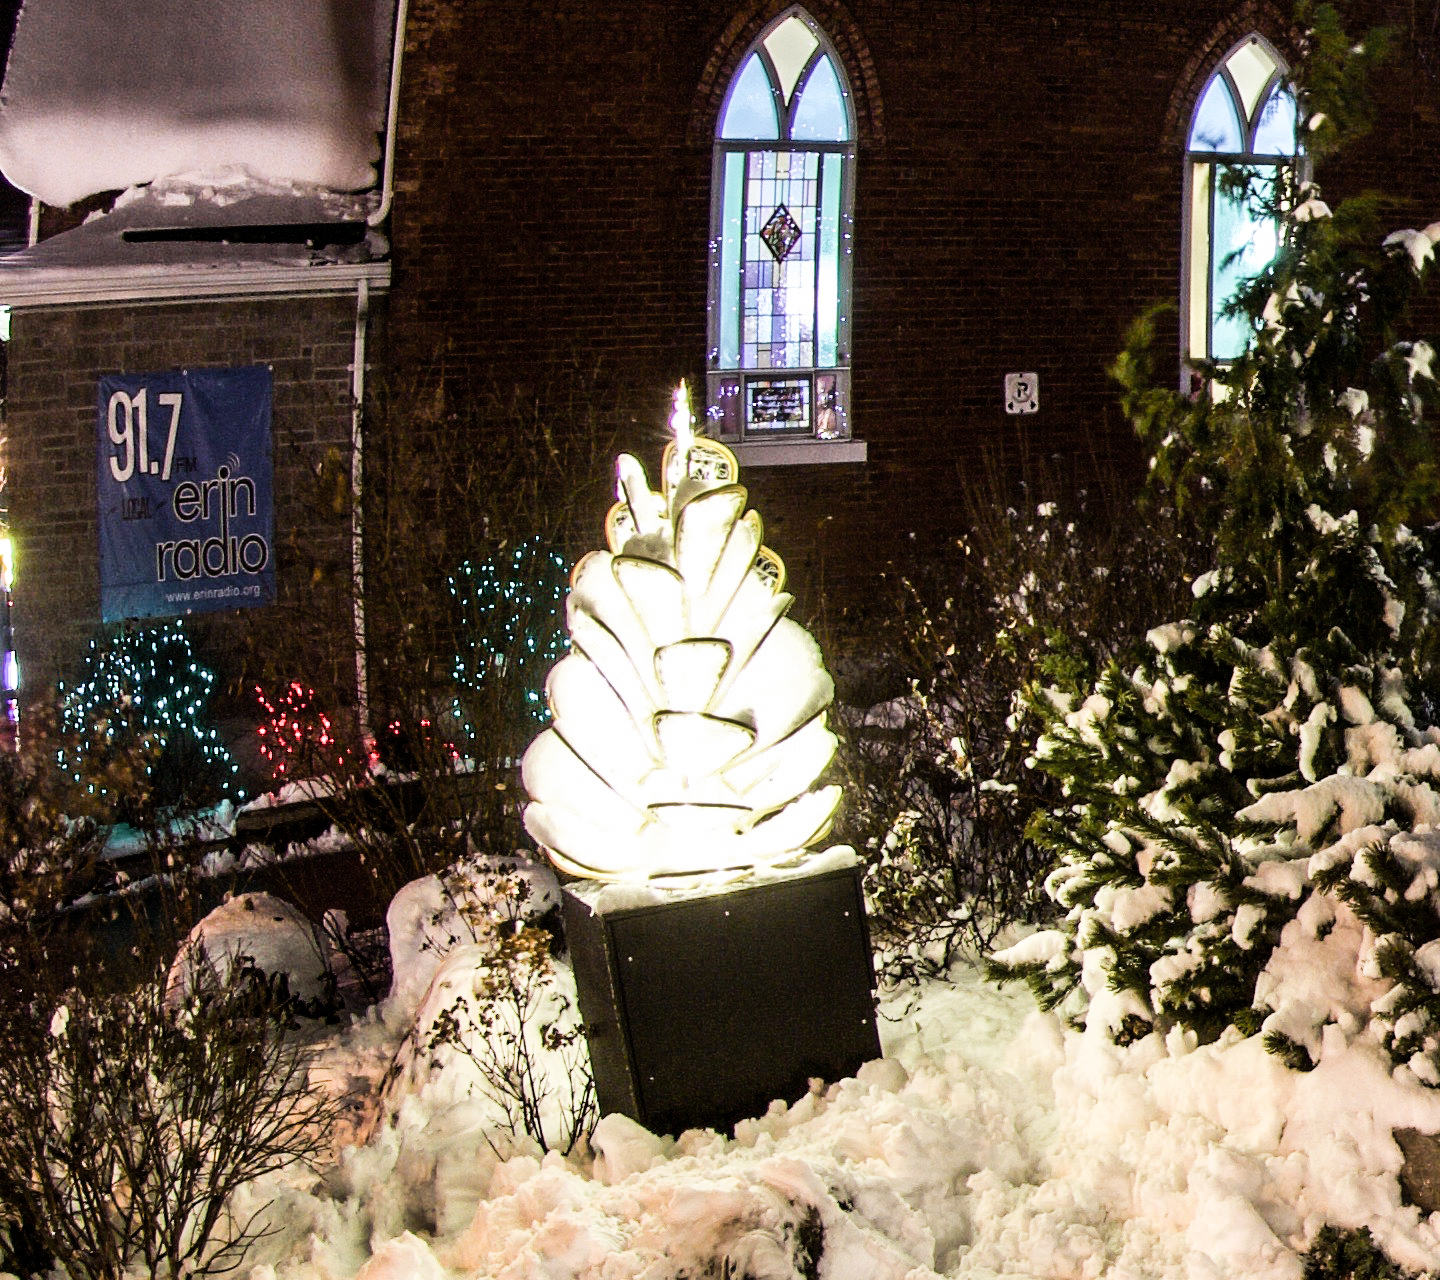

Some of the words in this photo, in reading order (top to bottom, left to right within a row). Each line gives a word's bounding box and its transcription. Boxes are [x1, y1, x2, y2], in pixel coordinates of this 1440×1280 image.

[107, 387, 183, 482] 91.7
[176, 457, 198, 472] FM
[173, 466, 256, 522] erin
[156, 533, 269, 582] radio
[165, 585, 261, 603] www.erinradio.org
